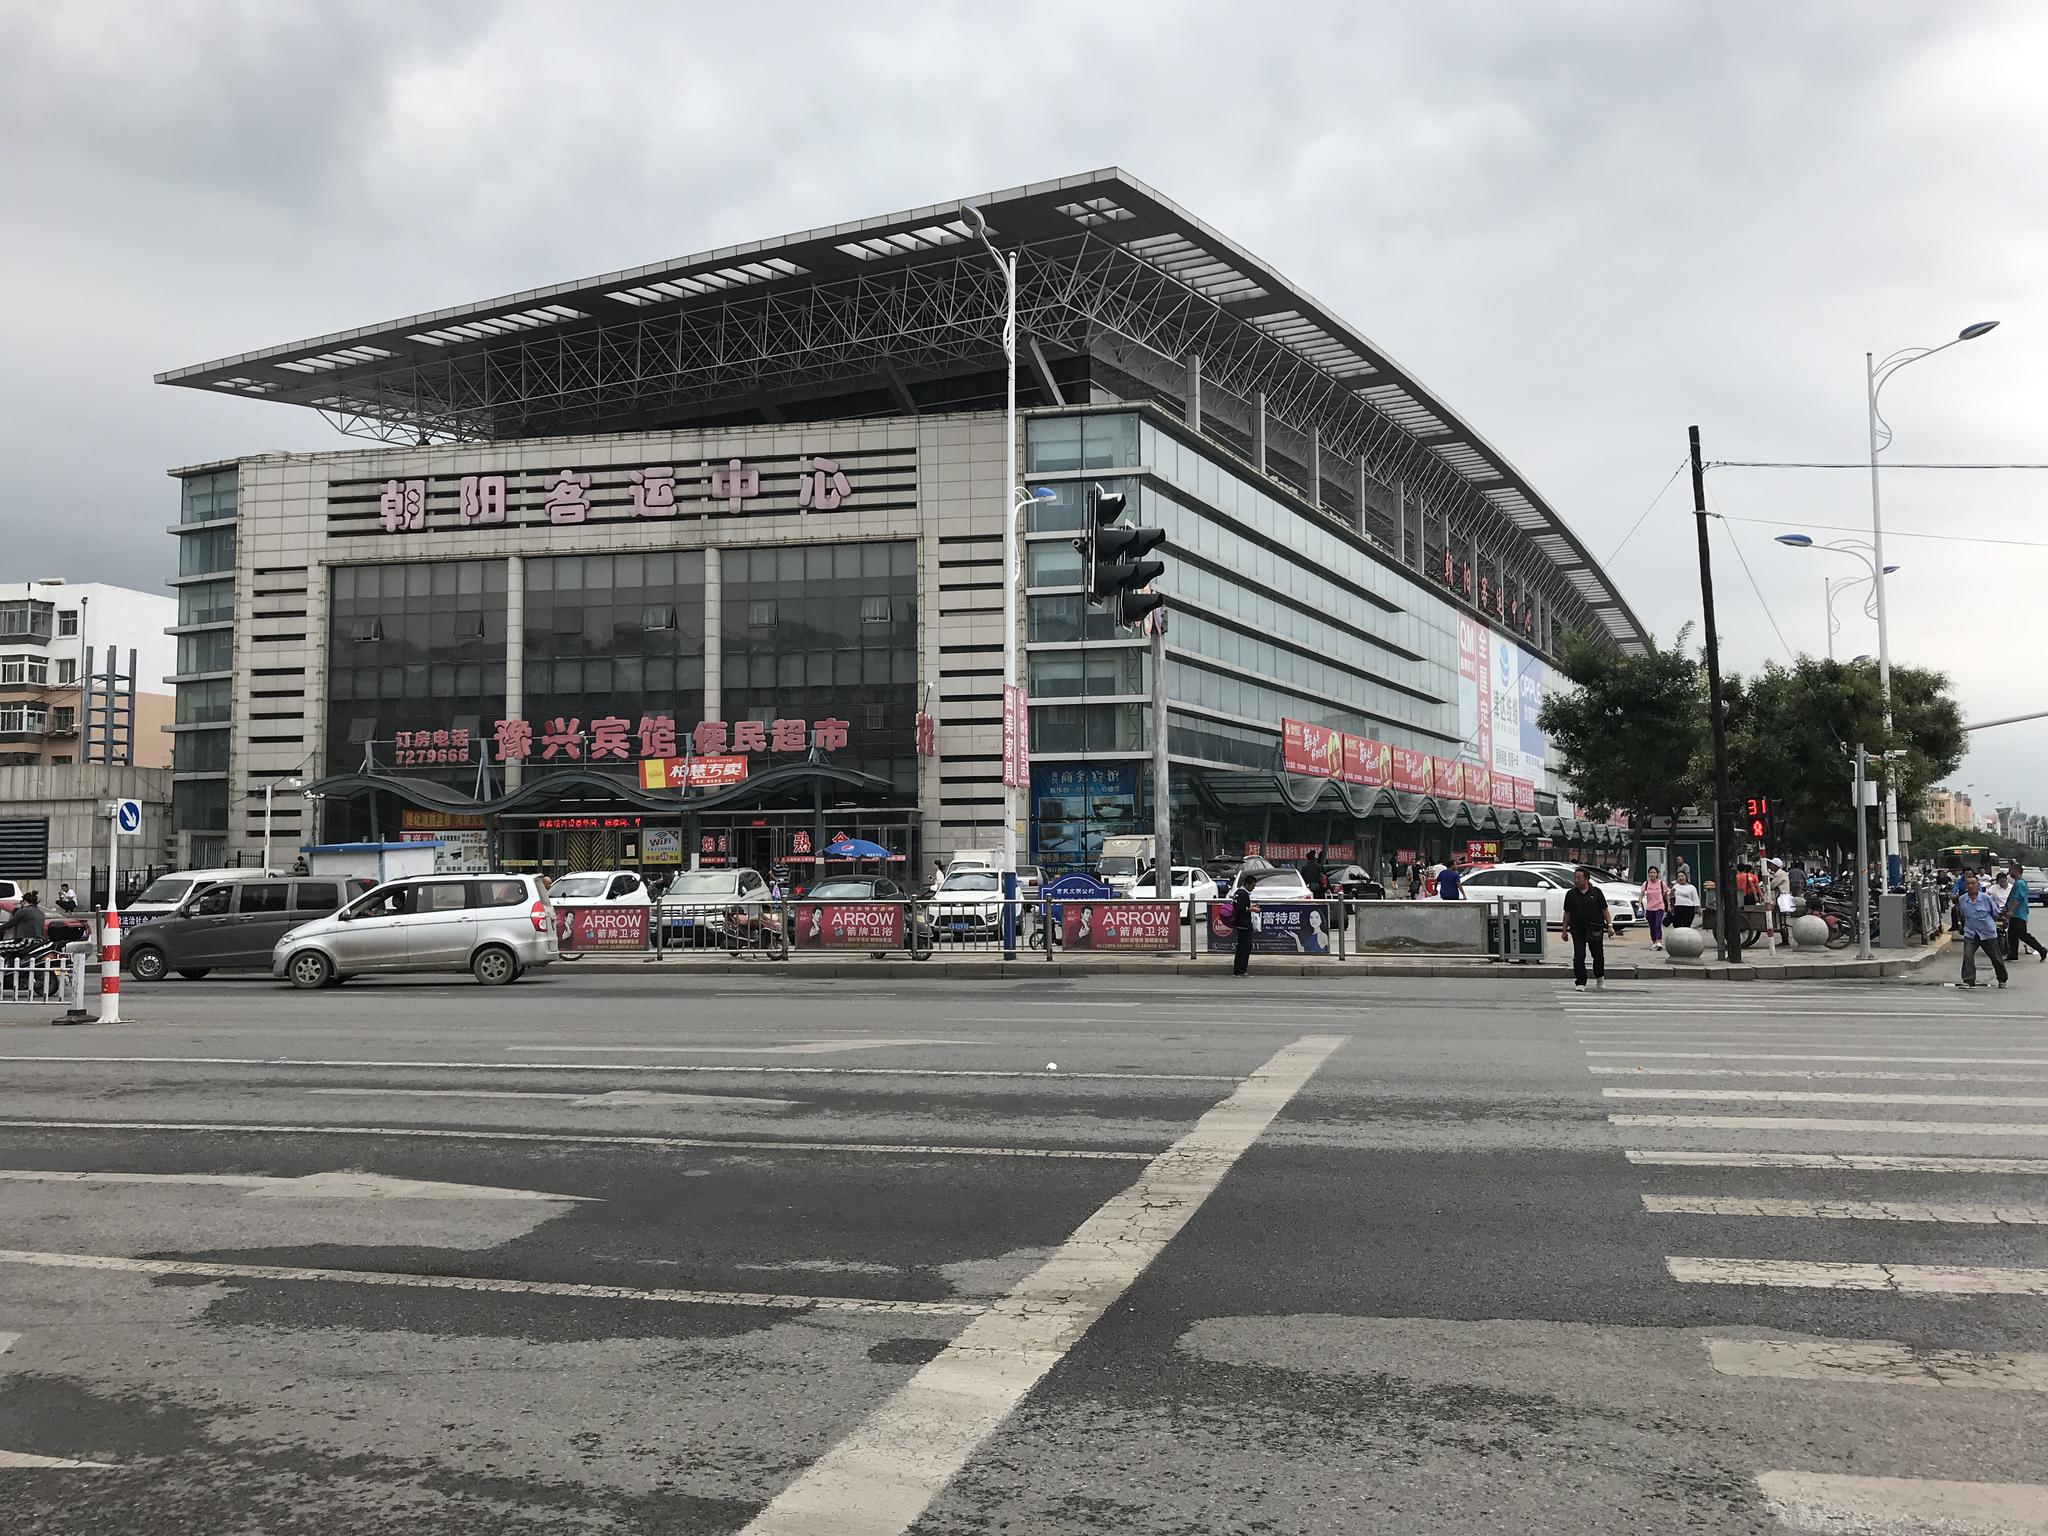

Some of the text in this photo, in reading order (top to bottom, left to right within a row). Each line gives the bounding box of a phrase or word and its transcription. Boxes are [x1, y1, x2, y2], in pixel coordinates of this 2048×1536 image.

[380, 457, 852, 533] 朝阳客运中心
[1460, 620, 1475, 654] QM
[395, 728, 469, 748] 订房电话
[494, 716, 850, 761] 豫兴宾馆 便民超市
[395, 749, 469, 764] 7279666
[1748, 800, 1767, 815] 31
[649, 837, 672, 846] WiFi
[583, 915, 641, 928] ARROW
[831, 913, 894, 926] ARROW
[1102, 912, 1170, 926] ARROW
[598, 928, 640, 938] 箭牌卫浴
[847, 926, 893, 937] 箭牌卫浴
[1119, 926, 1169, 937] 箭牌卫浴
